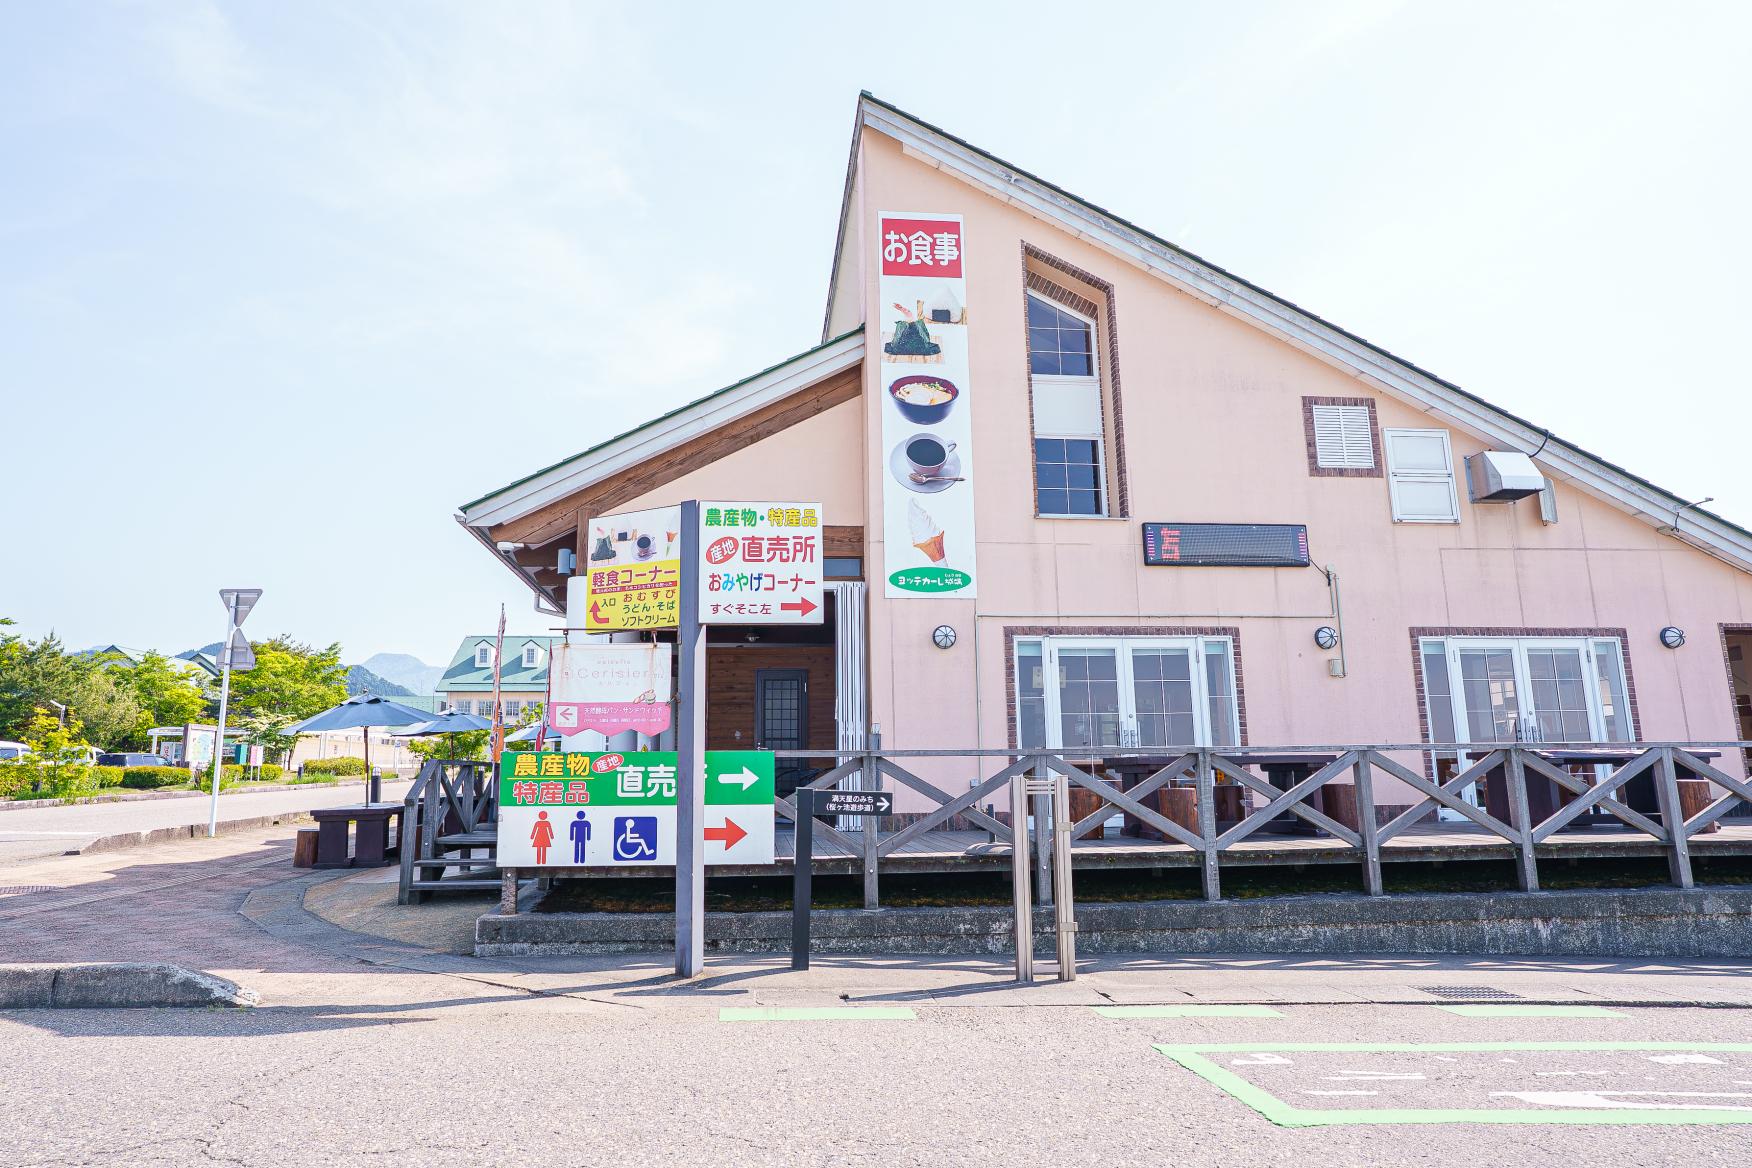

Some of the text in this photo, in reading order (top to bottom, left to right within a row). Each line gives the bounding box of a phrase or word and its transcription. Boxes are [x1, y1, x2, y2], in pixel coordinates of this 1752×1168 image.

[883, 229, 960, 267] お食事
[705, 508, 818, 527] 農産物・特産品
[710, 538, 736, 562] 産地
[741, 535, 816, 563] 直売所
[592, 566, 676, 587] 軽食コーナー
[708, 572, 816, 592] おみやげコーナー
[601, 598, 616, 608] 入口
[623, 589, 676, 603] おむすび
[622, 600, 675, 614] うどん・そば
[710, 603, 772, 615] すぐそこ左
[621, 613, 675, 627] ソフトクリーム
[513, 753, 591, 777] 農産物
[596, 755, 621, 772] 産地
[616, 763, 707, 798] 直売
[513, 781, 590, 805] 特産品
[831, 794, 874, 803] 満天星のみち
